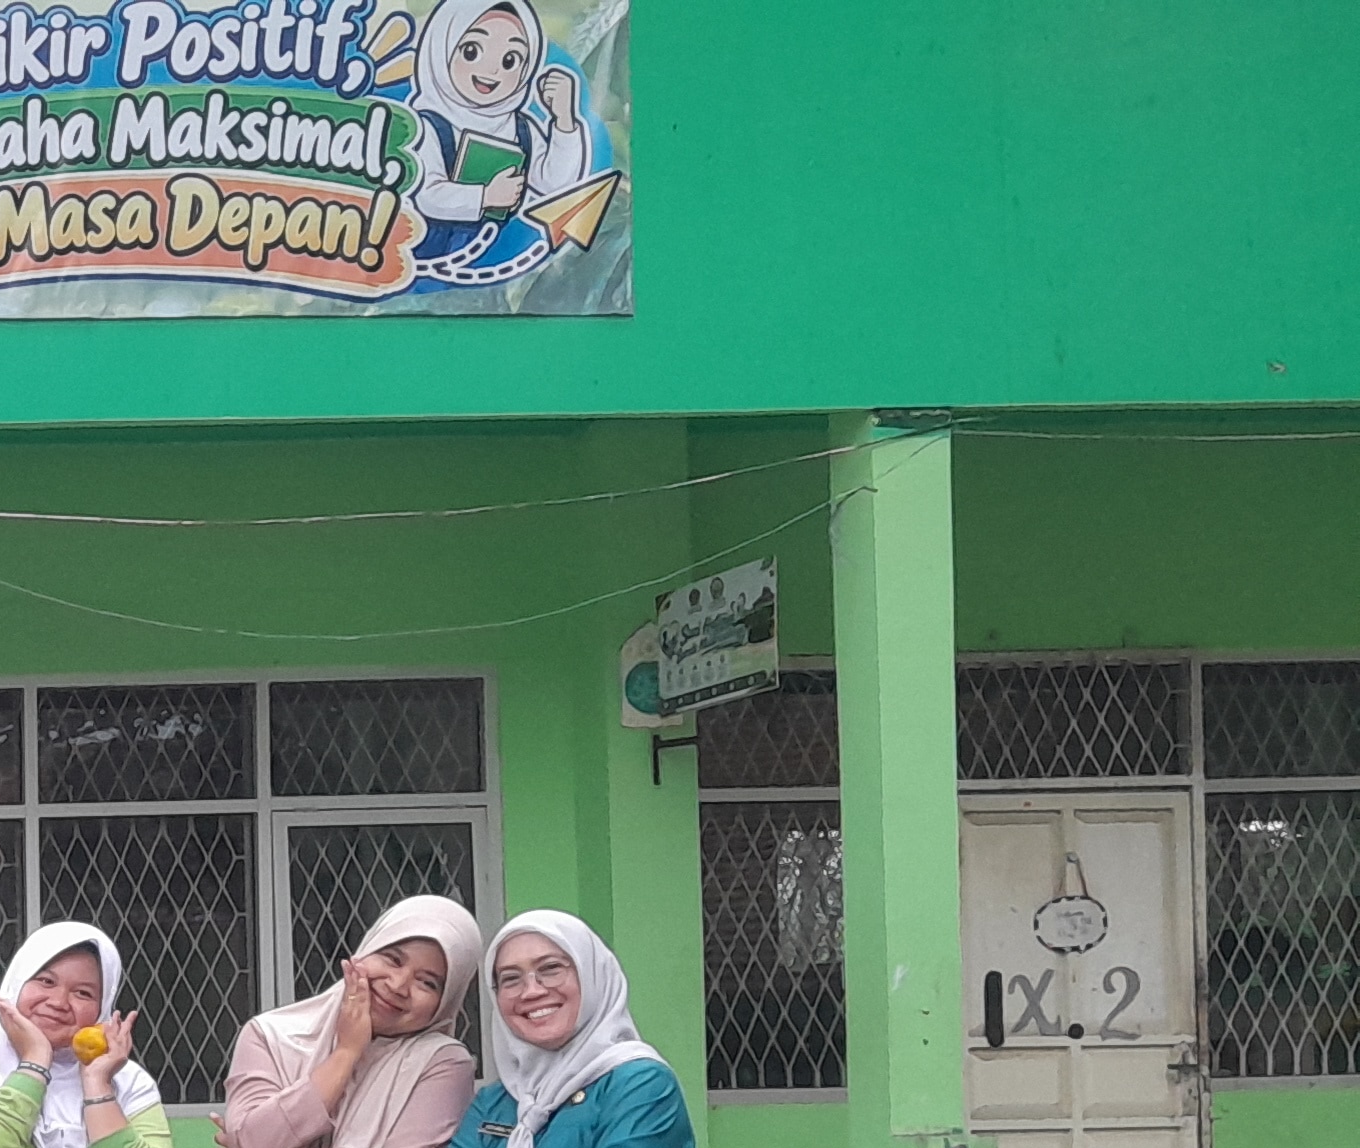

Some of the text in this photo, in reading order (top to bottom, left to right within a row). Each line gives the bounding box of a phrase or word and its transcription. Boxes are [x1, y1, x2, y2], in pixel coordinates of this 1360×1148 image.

[121, 0, 367, 91] Positif,
[110, 94, 403, 184] Maksimal,
[169, 178, 396, 268] Depan!
